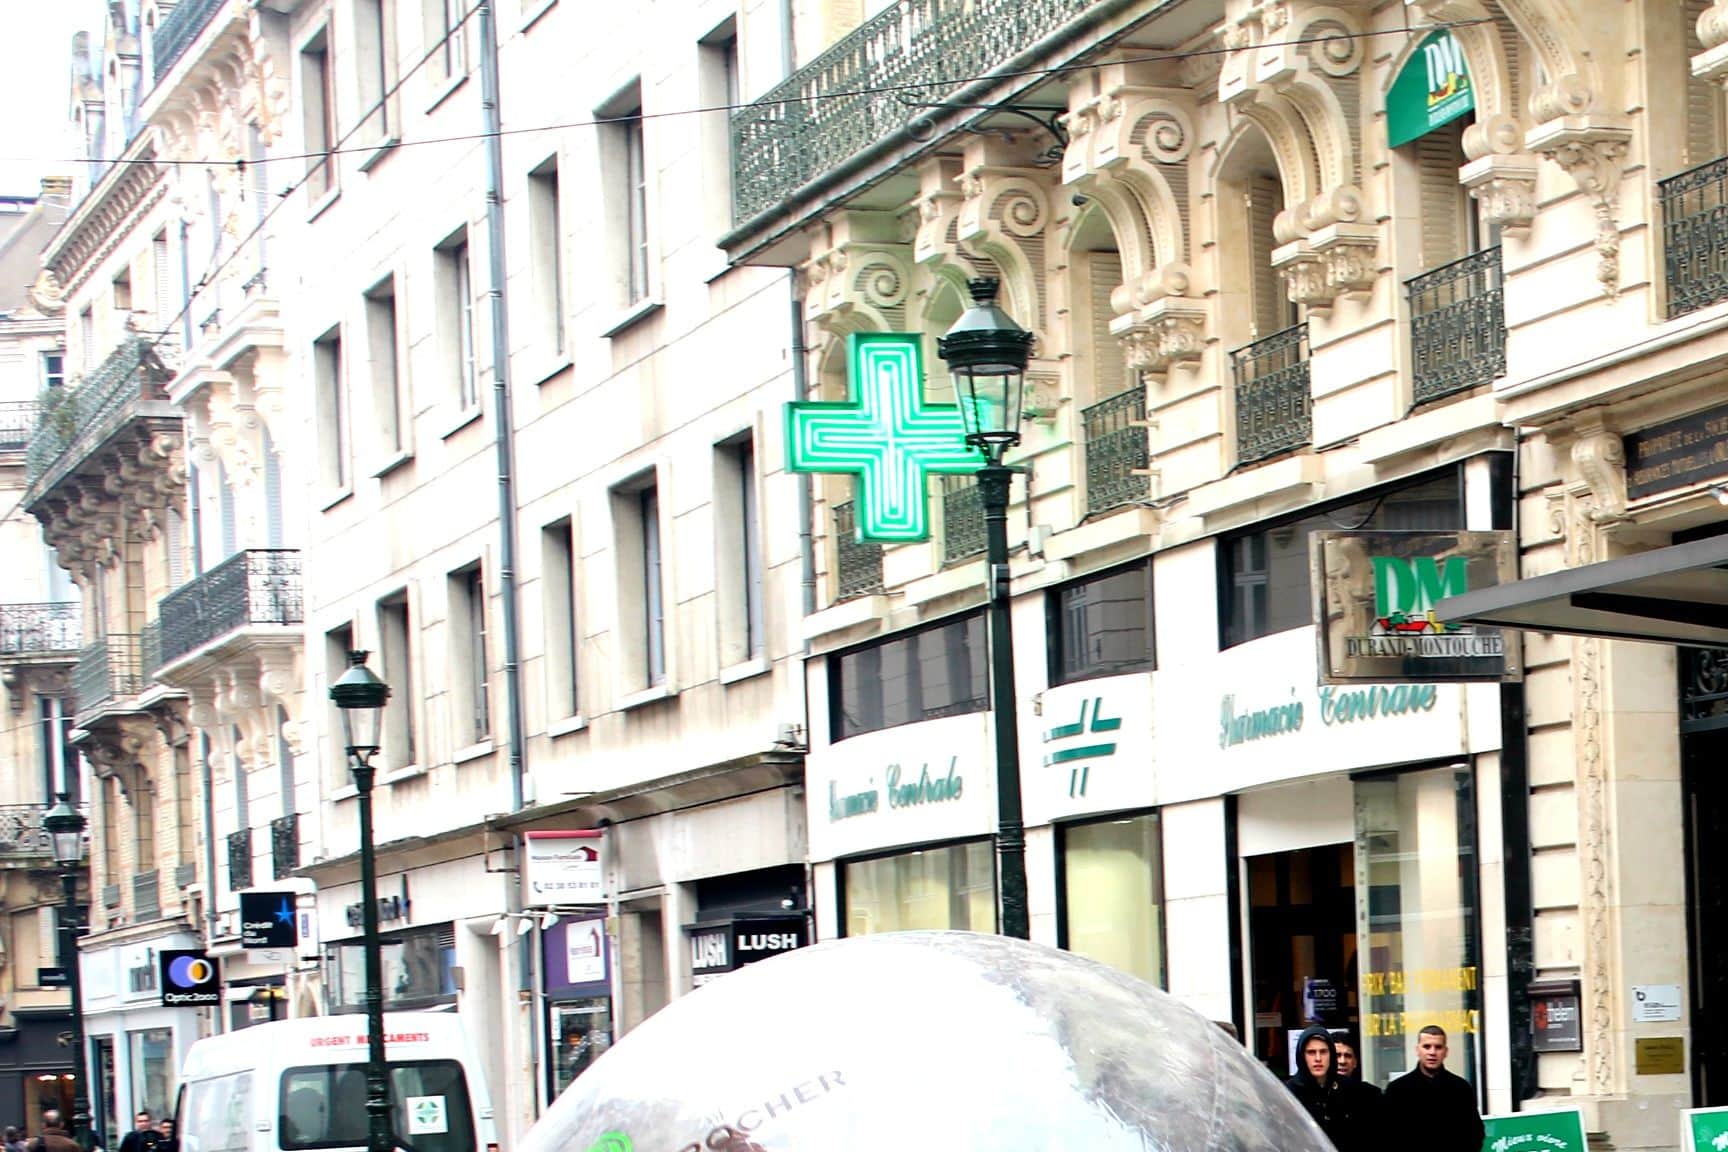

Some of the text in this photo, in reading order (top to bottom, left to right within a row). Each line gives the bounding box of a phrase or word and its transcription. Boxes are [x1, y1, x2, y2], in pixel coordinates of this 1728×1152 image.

[1369, 556, 1471, 620] DM
[886, 755, 964, 810] Centrale
[690, 932, 728, 969] LUSH
[737, 932, 798, 951] LUSH
[310, 1035, 351, 1048] URGENT
